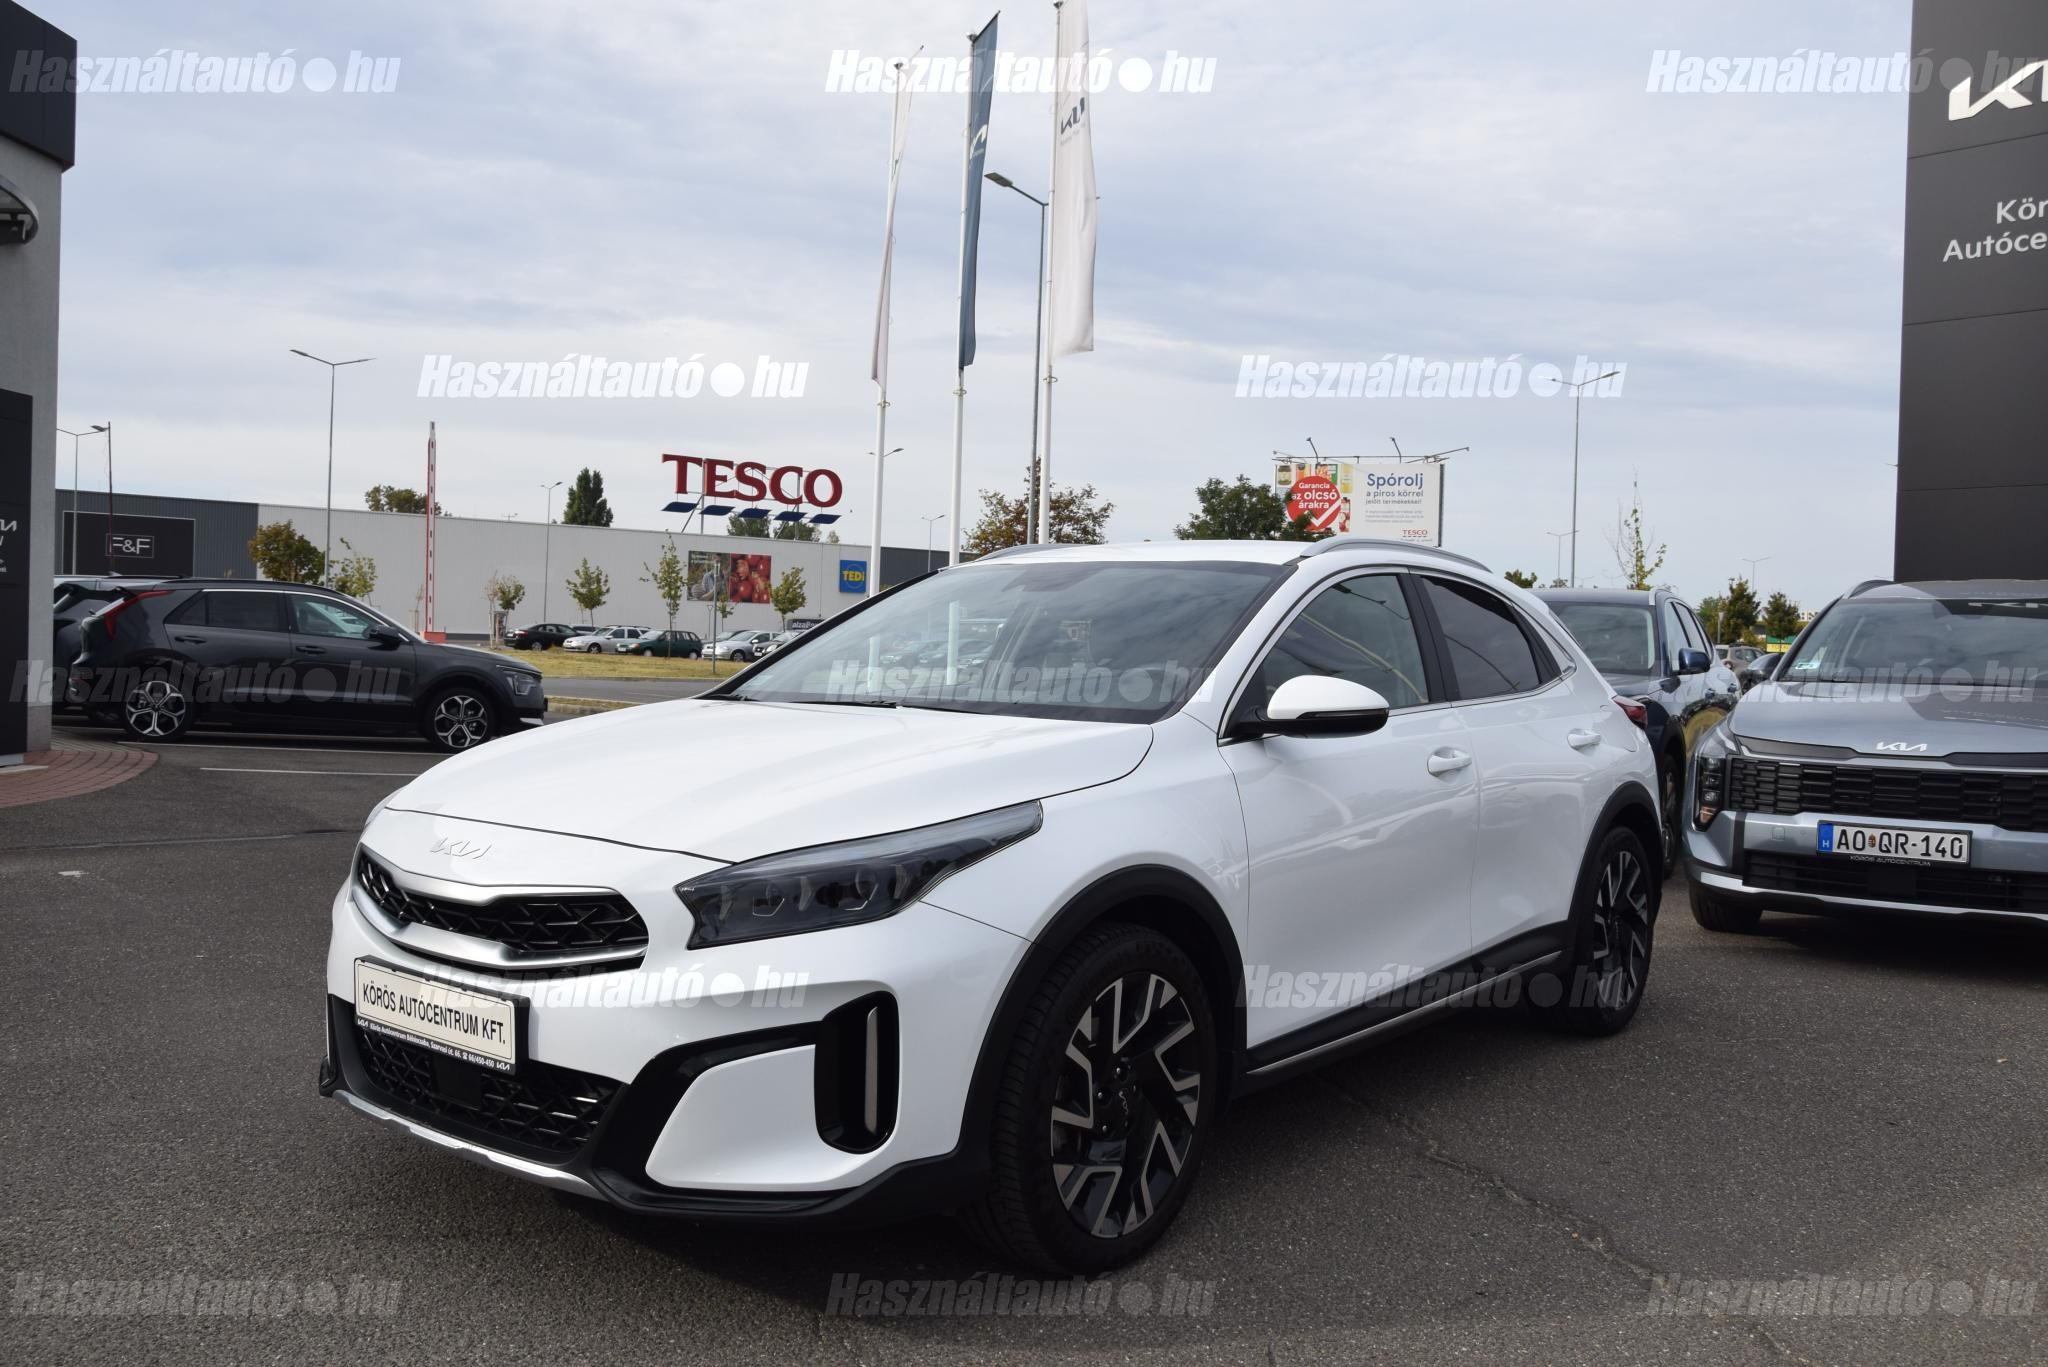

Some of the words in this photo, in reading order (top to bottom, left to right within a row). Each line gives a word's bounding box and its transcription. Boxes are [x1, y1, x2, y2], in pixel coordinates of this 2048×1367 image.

[1943, 231, 2047, 262] Autóce
[662, 454, 843, 507] TESCO
[1367, 473, 1423, 490] Spórolj
[1304, 488, 1338, 500] olcsó
[1373, 489, 1395, 498] piros
[1397, 489, 1423, 497] körrel
[1298, 500, 1329, 509] árakra
[109, 537, 150, 554] F&F
[1876, 742, 1928, 752] KIA
[1822, 840, 1830, 848] H
[363, 980, 396, 1012] KÖRÖS
[399, 994, 479, 1037] AUTÓCENTRUM
[482, 1017, 506, 1044] KFT.
